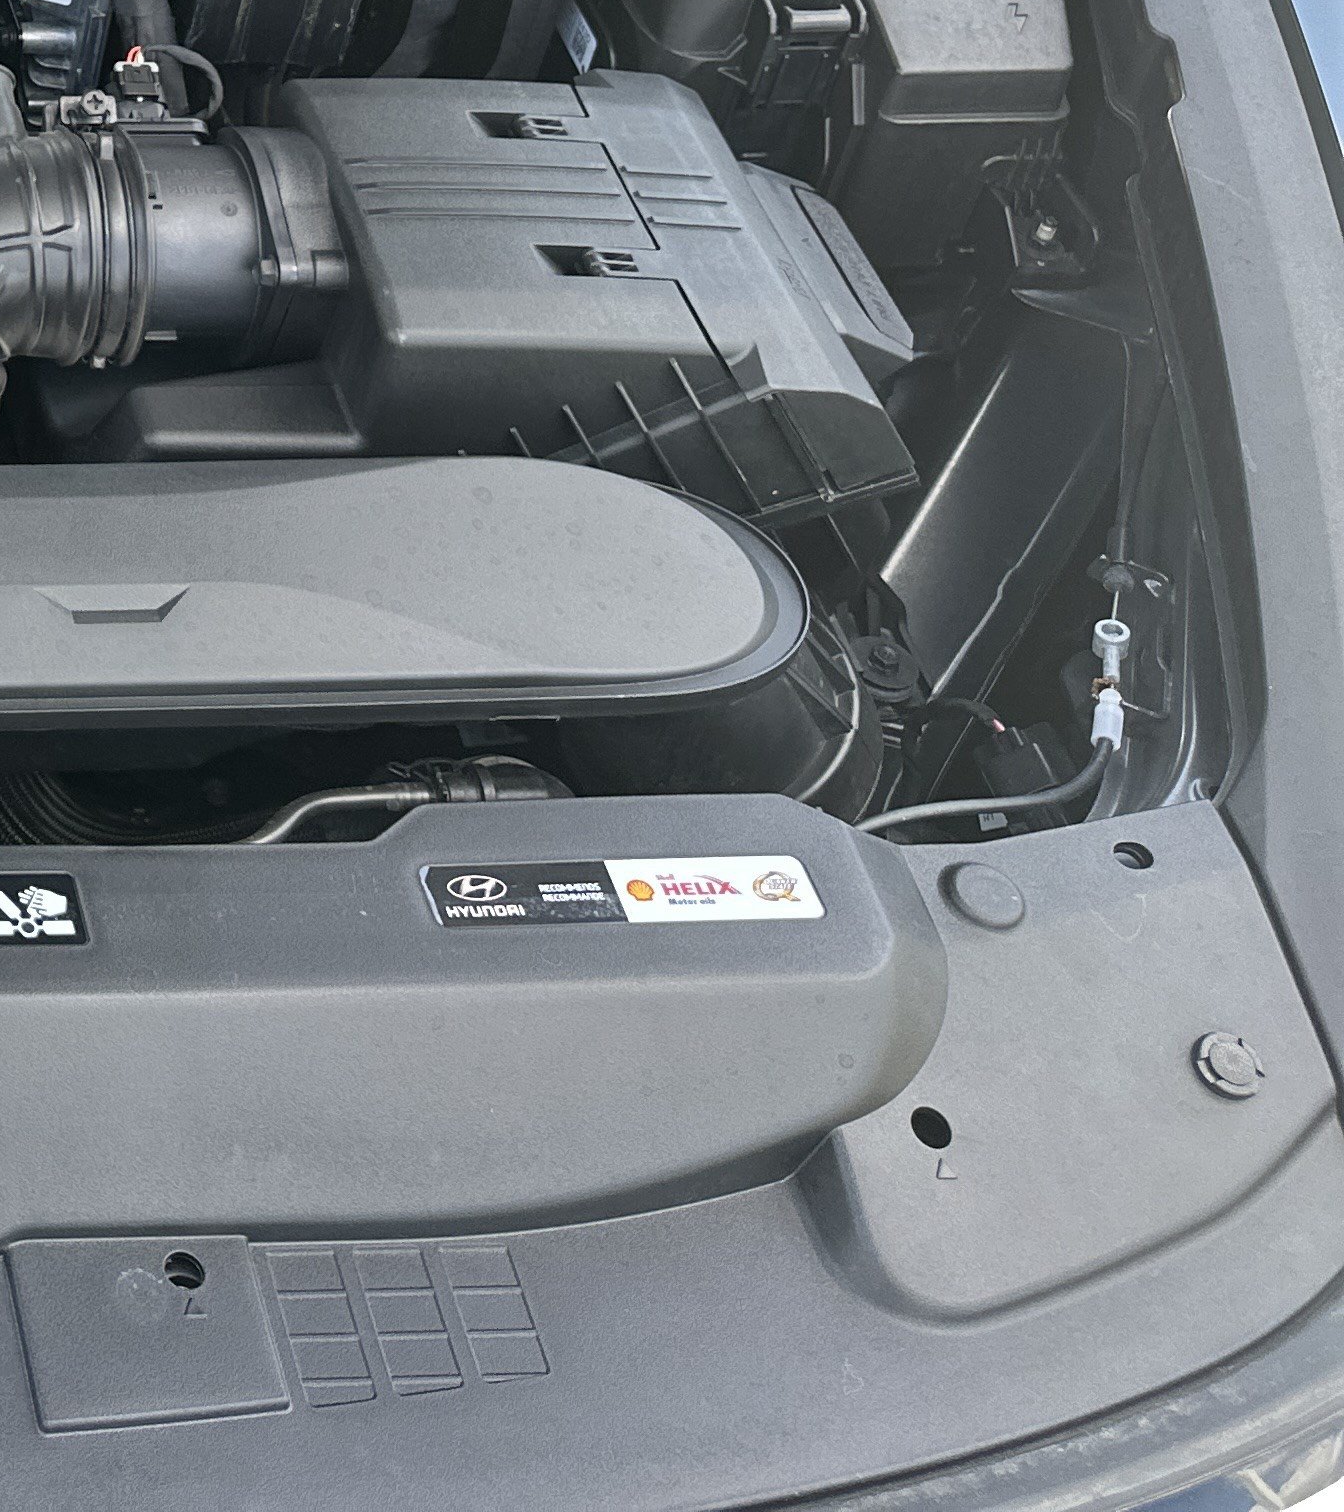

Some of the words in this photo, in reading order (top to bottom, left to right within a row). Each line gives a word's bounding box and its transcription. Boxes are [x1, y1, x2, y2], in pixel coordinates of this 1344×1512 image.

[538, 882, 602, 893] RECOMMENDS
[660, 881, 739, 896] HELIX
[445, 904, 526, 918] HYUNDAI
